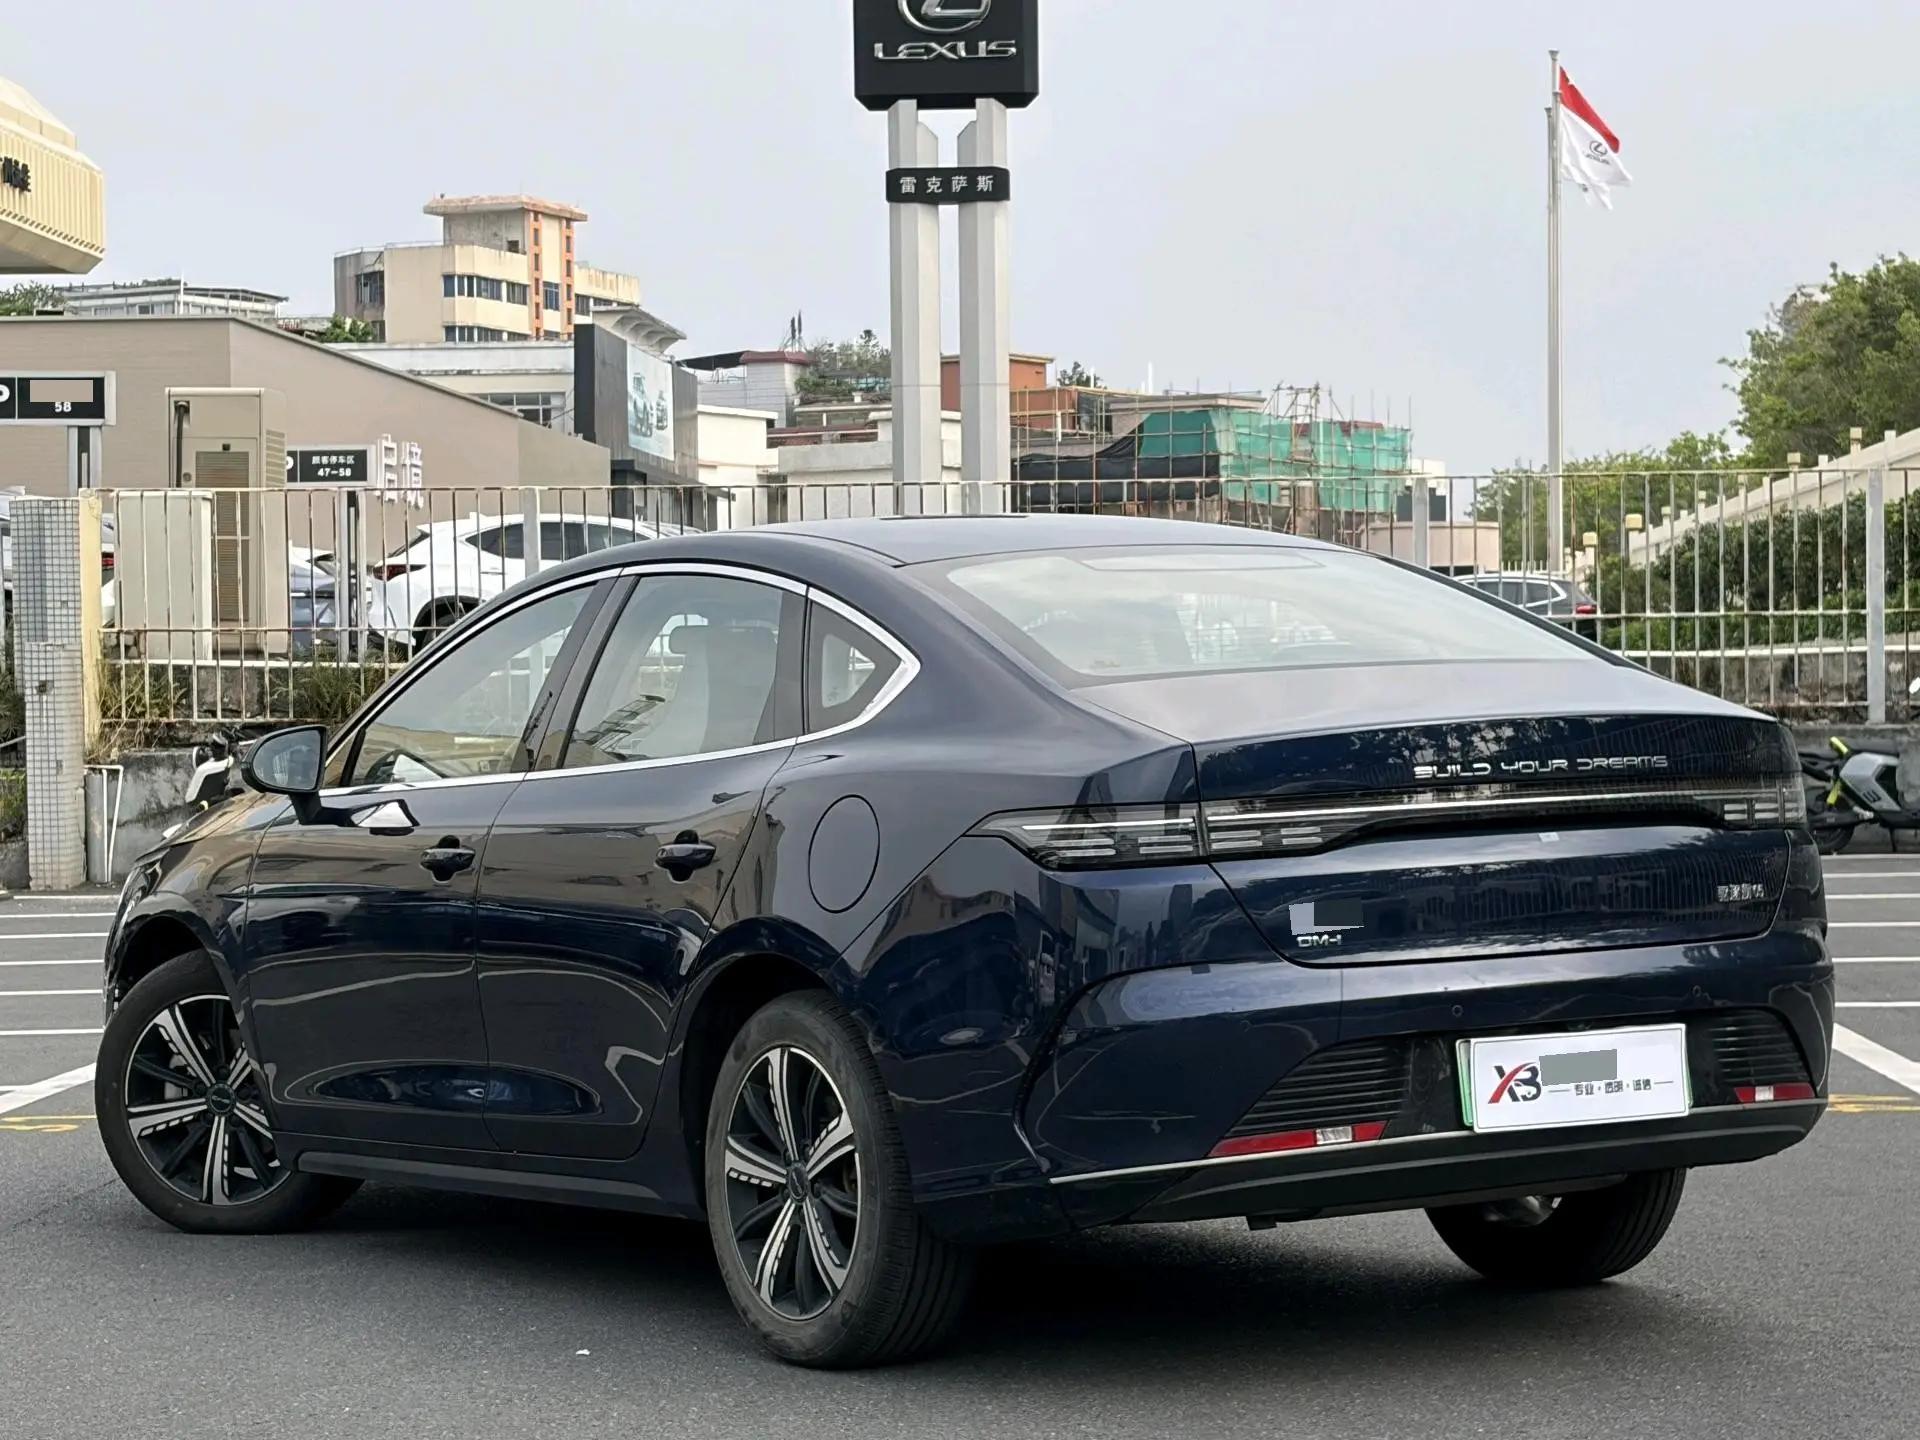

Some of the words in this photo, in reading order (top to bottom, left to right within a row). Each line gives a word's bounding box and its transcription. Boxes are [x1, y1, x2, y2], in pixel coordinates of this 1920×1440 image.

[874, 40, 1016, 60] LEXUS
[900, 175, 993, 194] 雷克萨斯
[54, 401, 72, 413] 58
[312, 455, 355, 465] 顾客停车区
[1414, 762, 1491, 779] BUILD
[1501, 759, 1569, 773] YOUR
[1577, 755, 1669, 771] DREAMS
